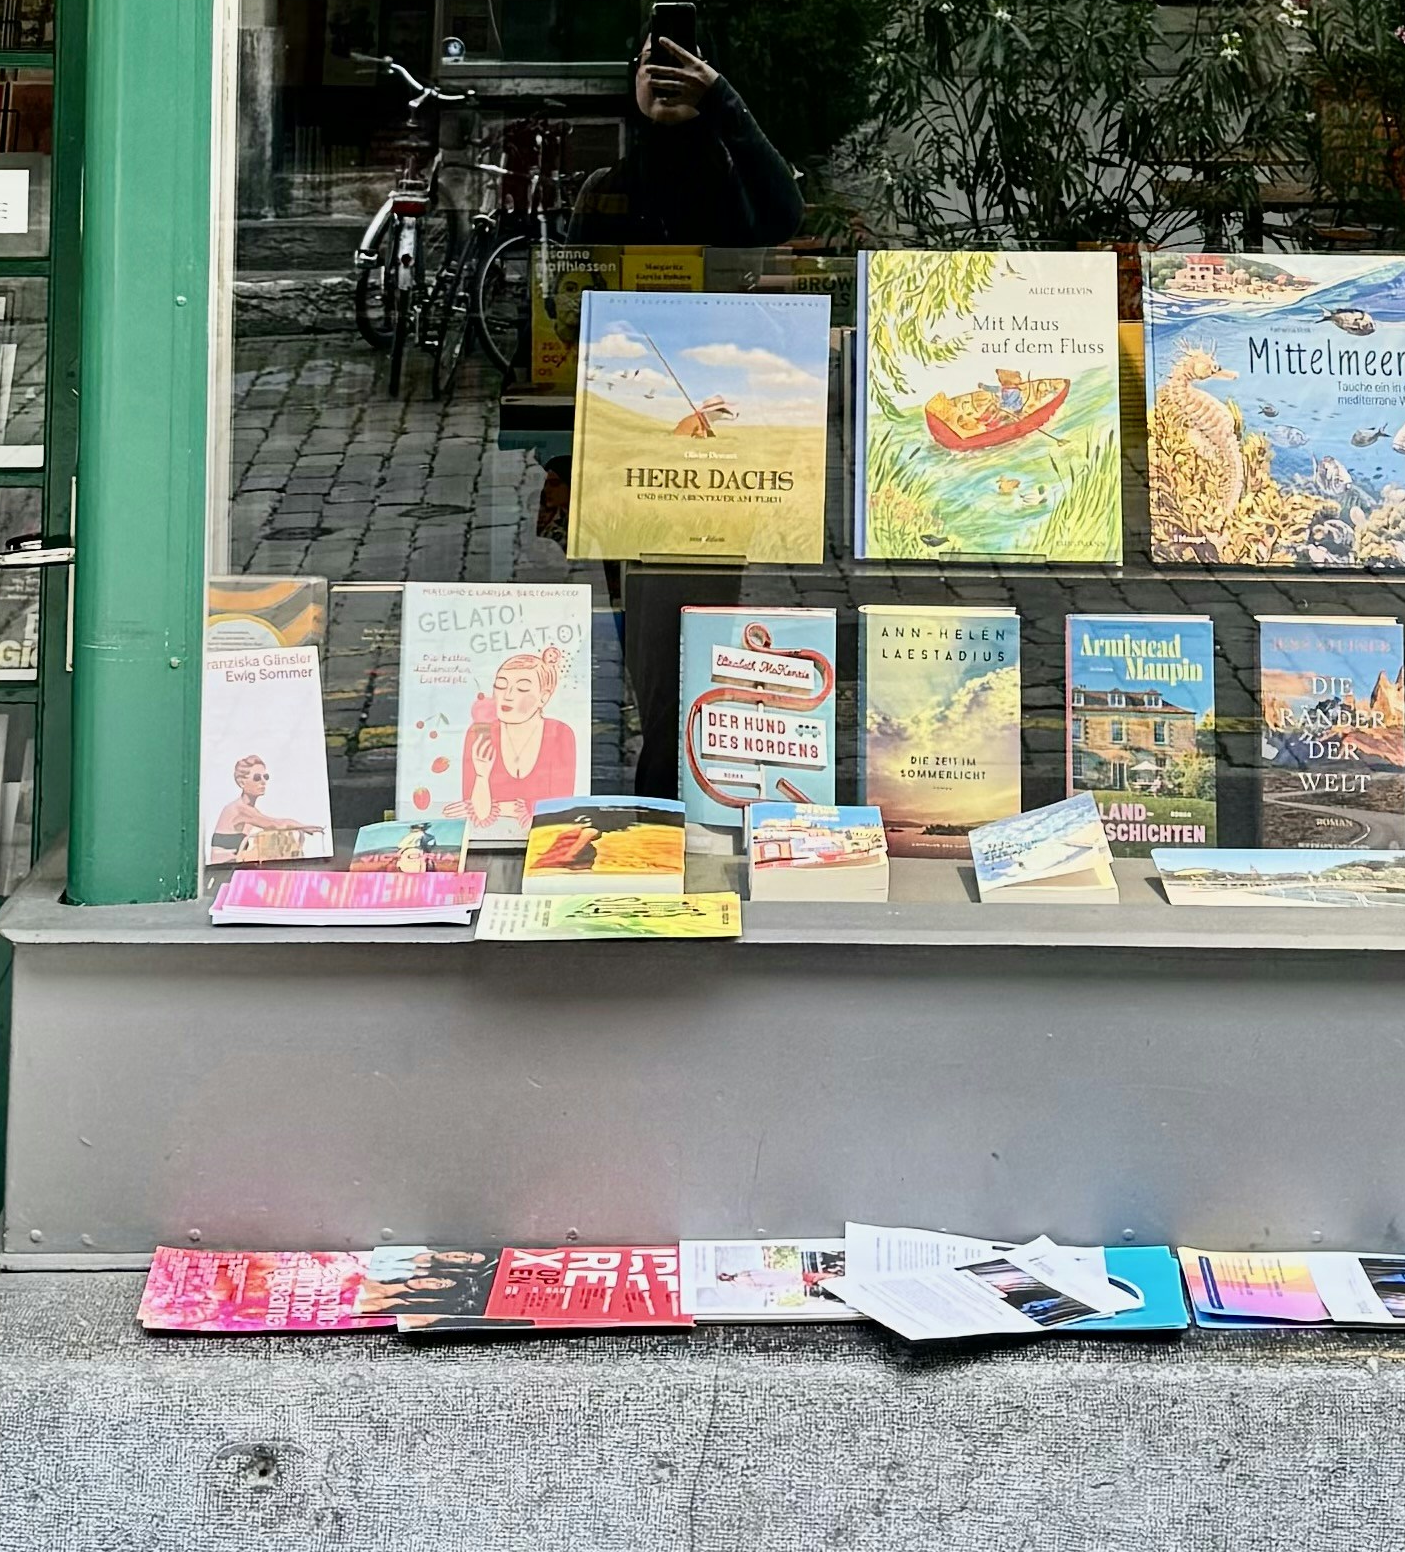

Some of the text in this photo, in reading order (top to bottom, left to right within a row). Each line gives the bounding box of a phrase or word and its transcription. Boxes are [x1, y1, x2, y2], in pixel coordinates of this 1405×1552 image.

[1029, 287, 1093, 296] ALICE MELVIN
[972, 315, 1059, 332] Mit Maus
[981, 338, 1105, 354] auf dem Fluss
[1337, 381, 1373, 393] Tauche
[1375, 382, 1390, 393] ein
[1392, 382, 1401, 393] in
[1337, 394, 1397, 406] mediterrane
[624, 468, 794, 492] HERR DACHS
[417, 604, 525, 634] GELATO!
[469, 623, 584, 655] GELATO!
[881, 625, 1006, 642] ANN-HELÉN
[882, 648, 1006, 663] LAESTADIUS
[1080, 634, 1182, 660] Armistead
[263, 652, 313, 667] Gänsler
[225, 666, 314, 685] Ewig Sommer
[1125, 659, 1204, 687] Maupin
[1312, 677, 1354, 696] DIE
[708, 711, 787, 736] DER HUND
[1279, 706, 1387, 729] RÄNDER
[708, 732, 819, 759] DES NORDENS
[1308, 742, 1359, 761] DER
[910, 755, 977, 766] DIE ZEIT IM
[900, 768, 986, 781] SOMMERLICHT
[1297, 773, 1371, 795] WELT
